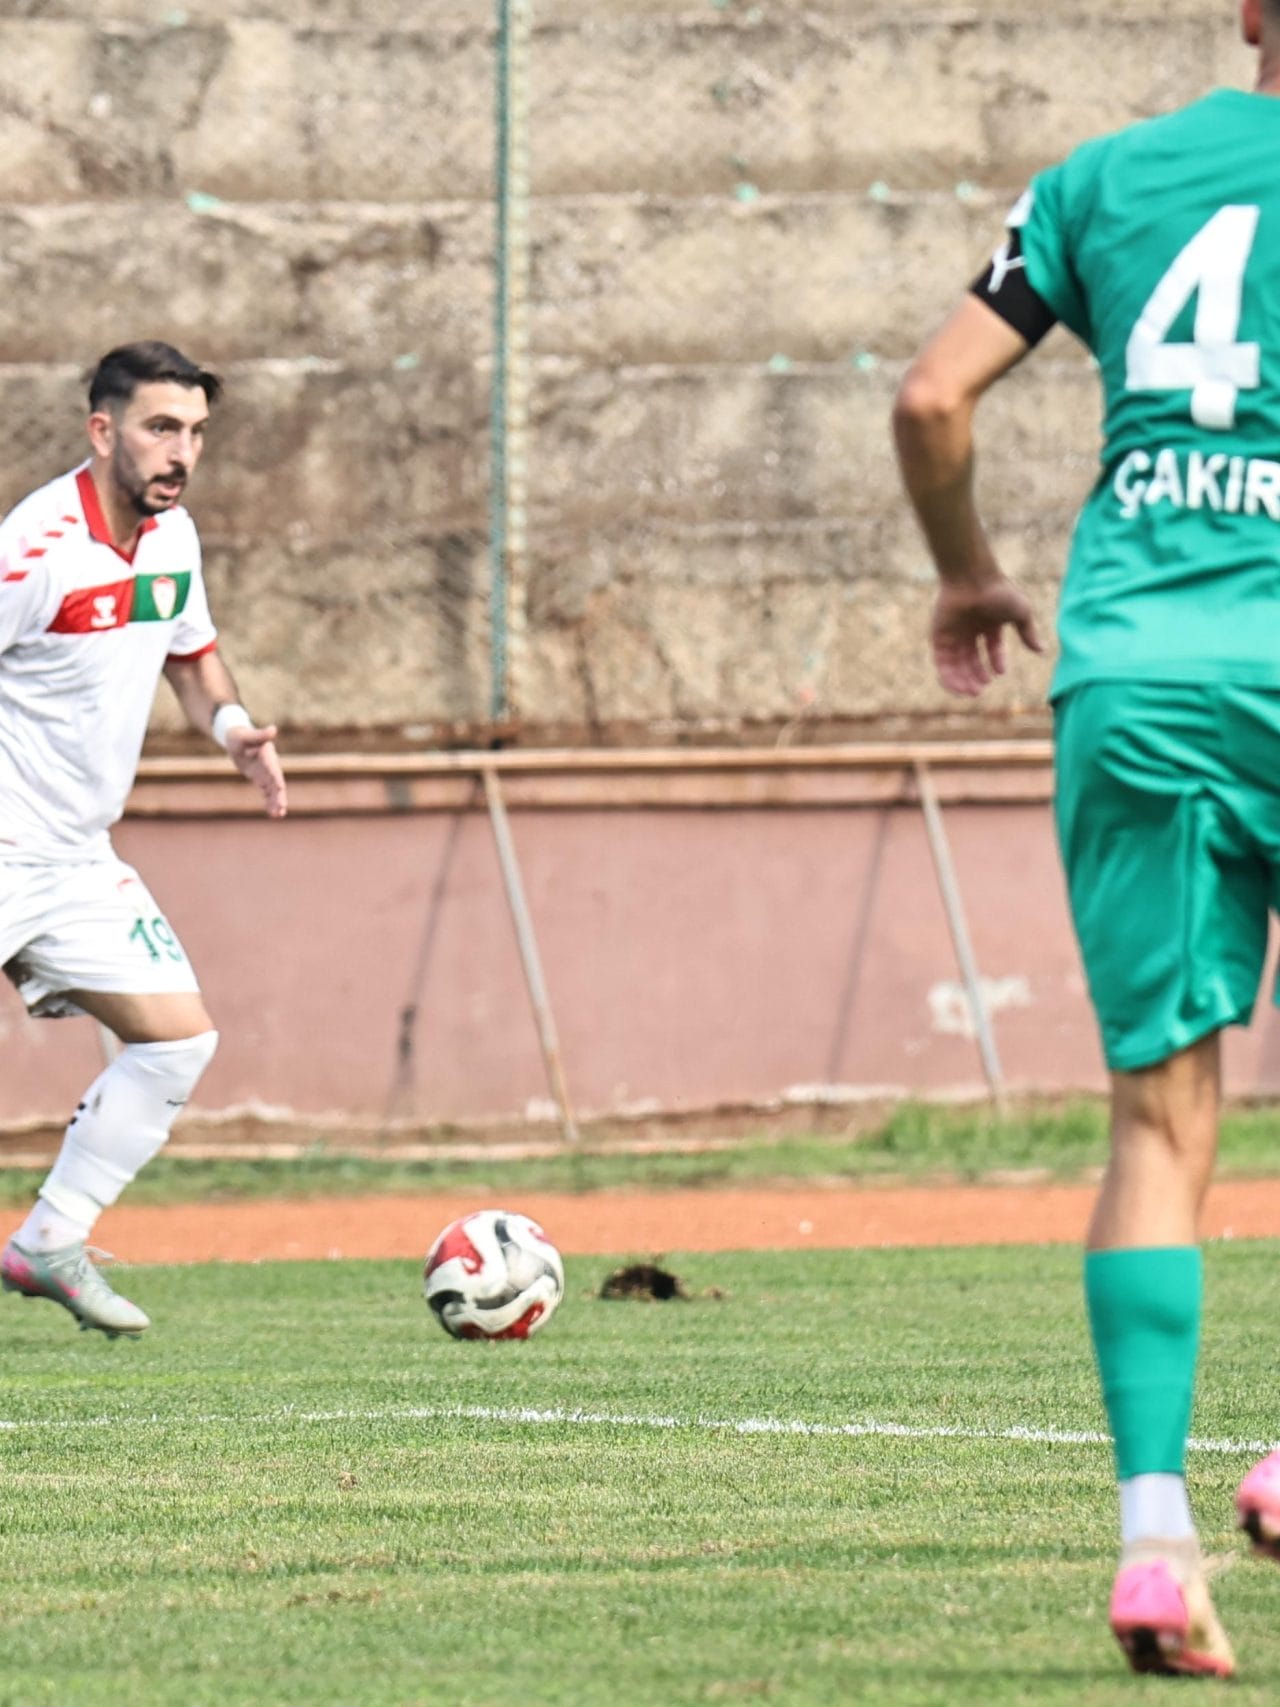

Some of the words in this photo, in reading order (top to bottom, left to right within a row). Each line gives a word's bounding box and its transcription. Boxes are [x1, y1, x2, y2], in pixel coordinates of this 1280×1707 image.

[1125, 204, 1260, 430] 4
[1114, 448, 1280, 521] ÇAKIR
[128, 917, 182, 962] 19
